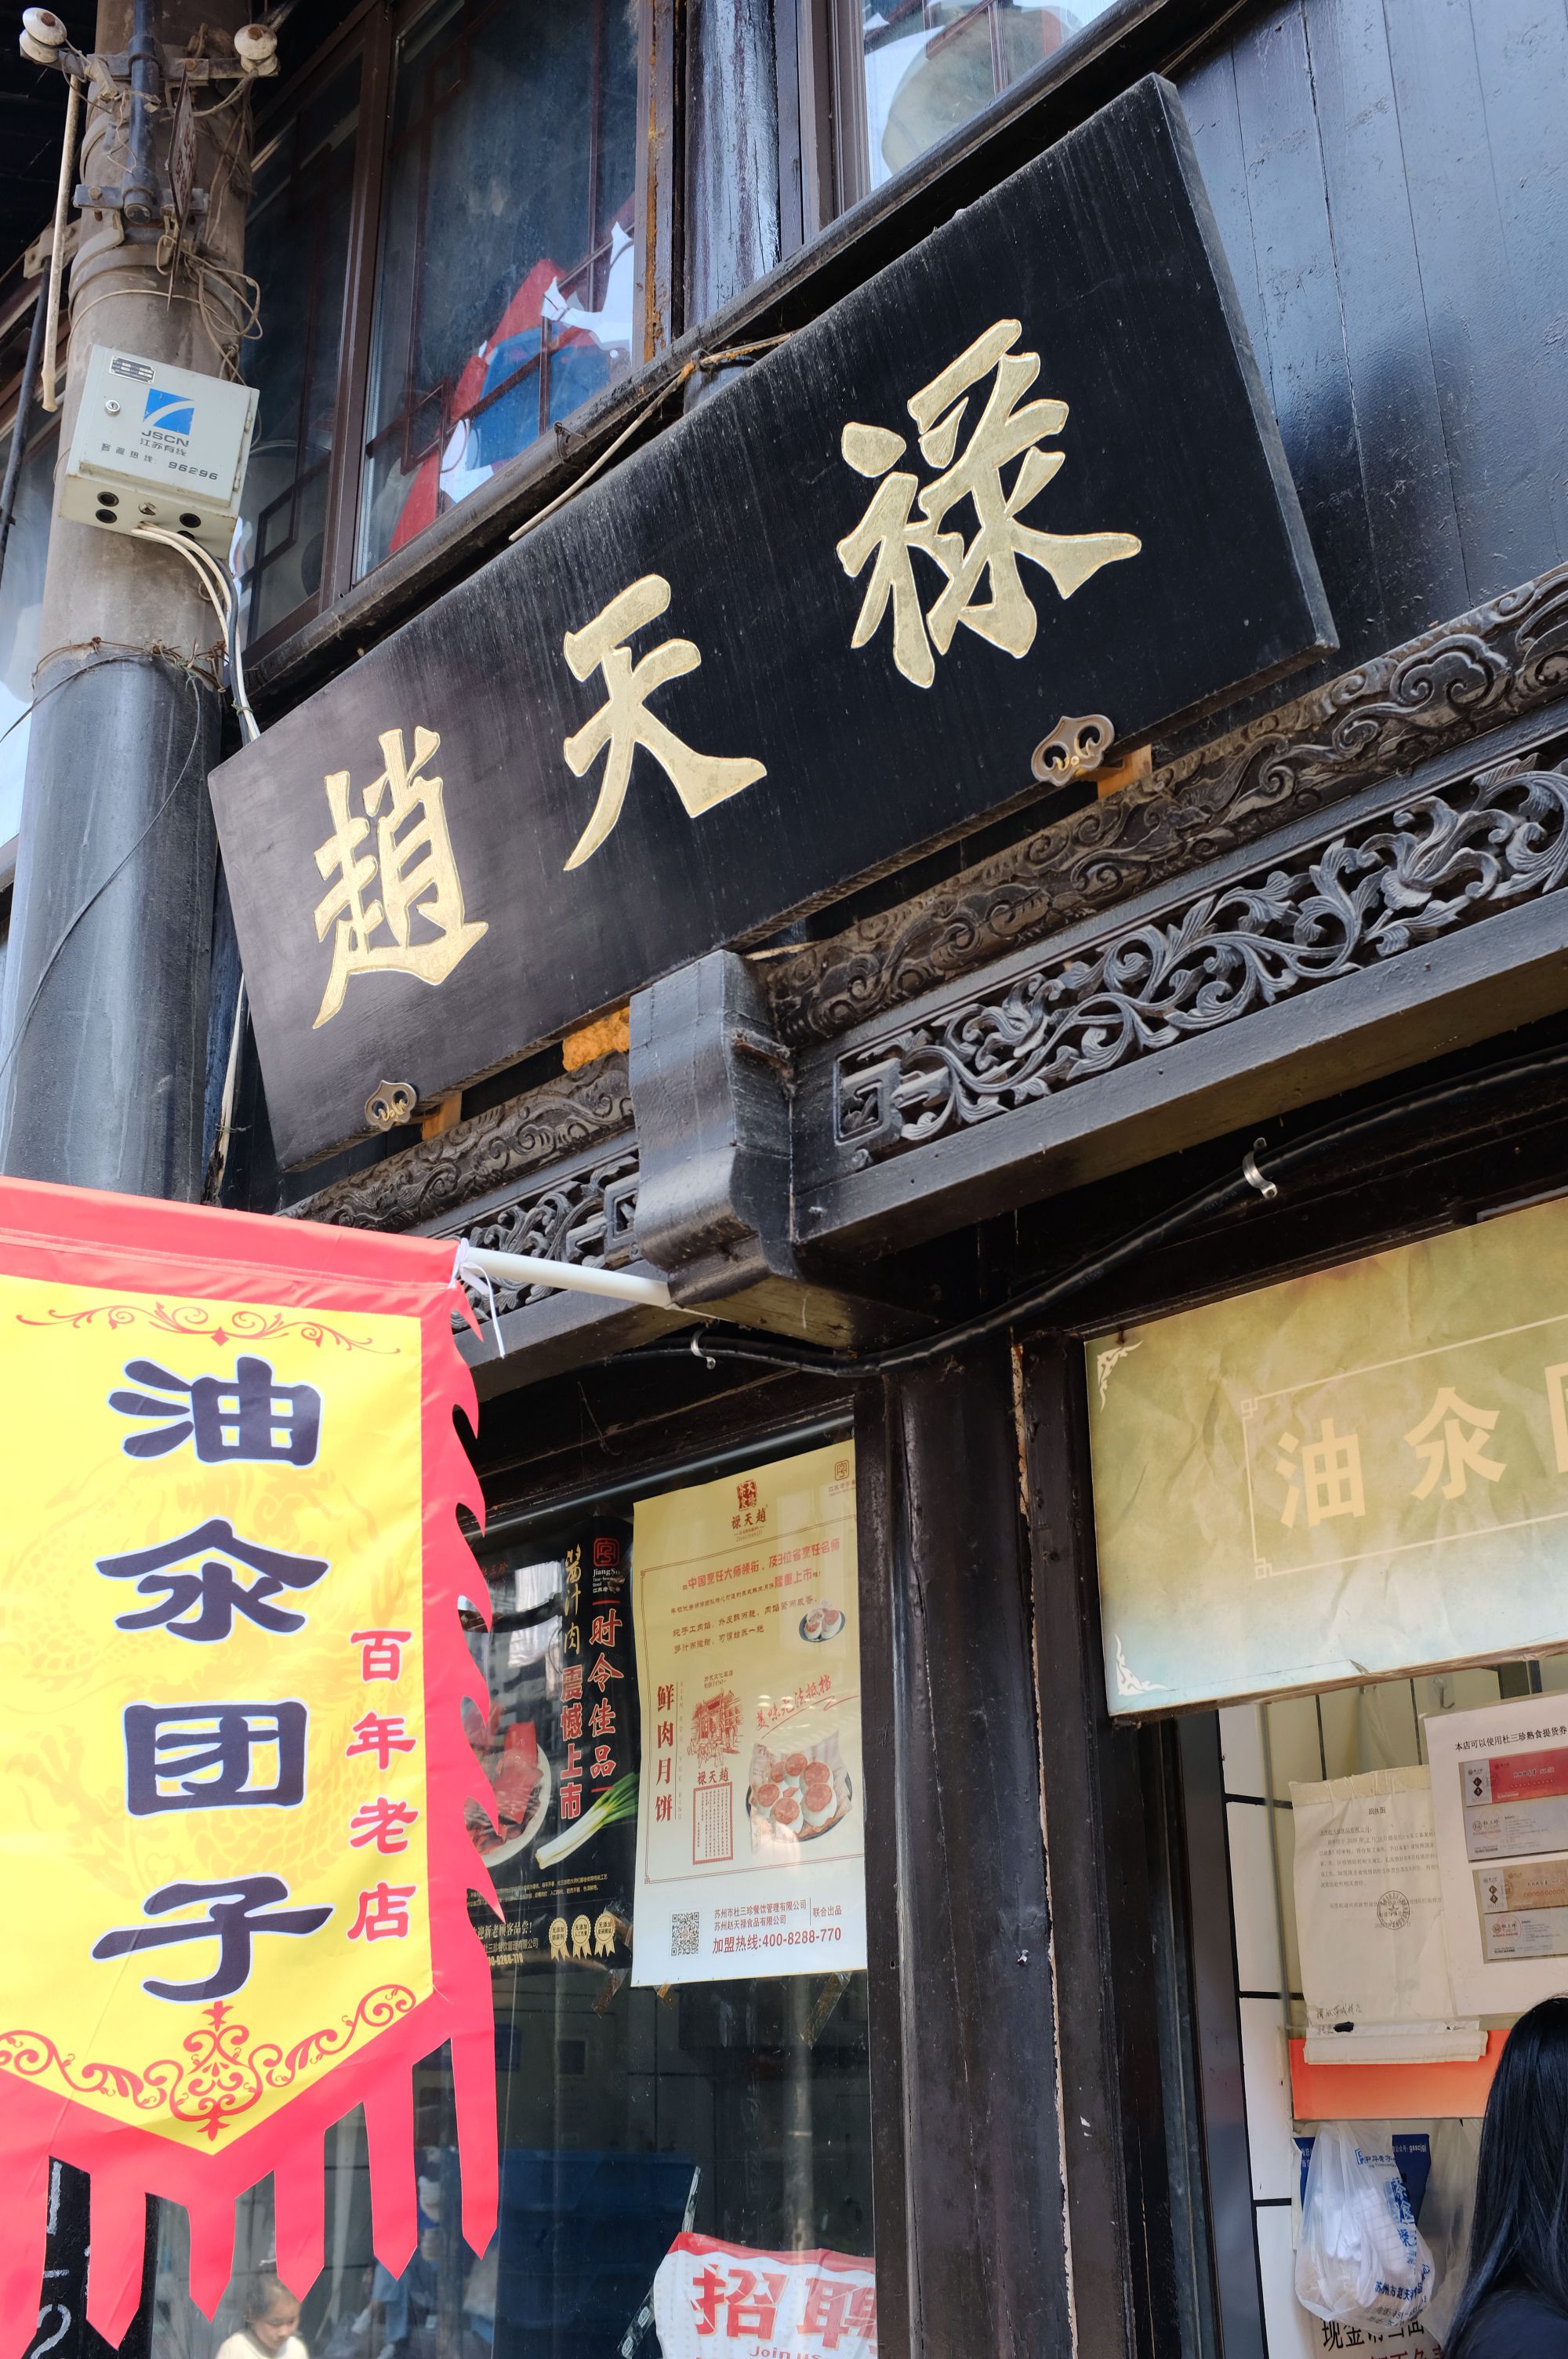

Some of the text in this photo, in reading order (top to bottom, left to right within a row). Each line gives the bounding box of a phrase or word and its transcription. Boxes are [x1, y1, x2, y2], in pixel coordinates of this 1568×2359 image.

[140, 438, 187, 457] 江苏有线
[141, 430, 189, 448] JSCN
[168, 461, 219, 481] 96296
[588, 1608, 625, 1779] 时令佳品
[560, 1664, 583, 1820] 震撼上市
[1455, 1725, 1568, 1751] 本店可以使用杜三珍熟食提货券
[655, 1684, 674, 1823] 鲜肉月饼
[346, 1629, 419, 1943] 百年老店
[714, 1899, 807, 1919] 苏州市杜三珍餐饮管理有限公司
[812, 1905, 842, 1918] 联合出品
[474, 1919, 533, 1939] 迎新老顾客品尝!
[714, 1914, 786, 1932] 苏州赵天禄食品有限公司
[750, 2346, 792, 2359] Join
